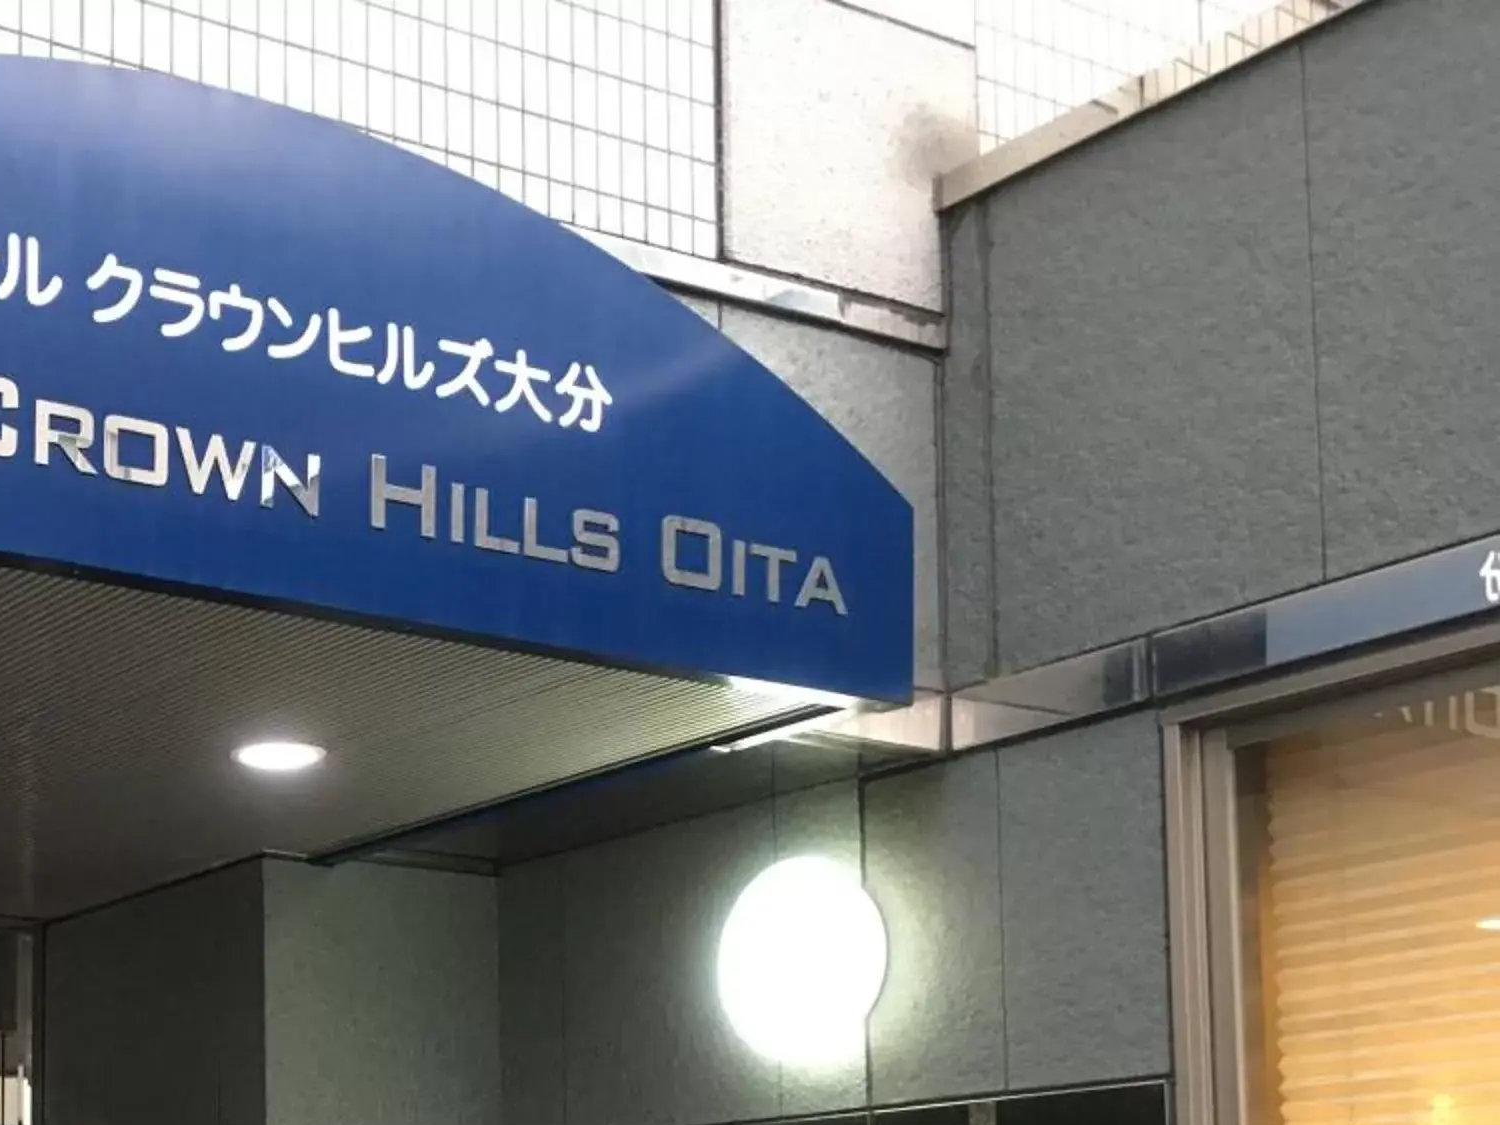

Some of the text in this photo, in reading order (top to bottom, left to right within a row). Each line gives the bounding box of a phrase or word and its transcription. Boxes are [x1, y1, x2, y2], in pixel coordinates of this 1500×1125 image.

[85, 253, 613, 433] クラウンヒルズ大分
[370, 453, 621, 575] HILLS
[660, 513, 849, 616] OITA
